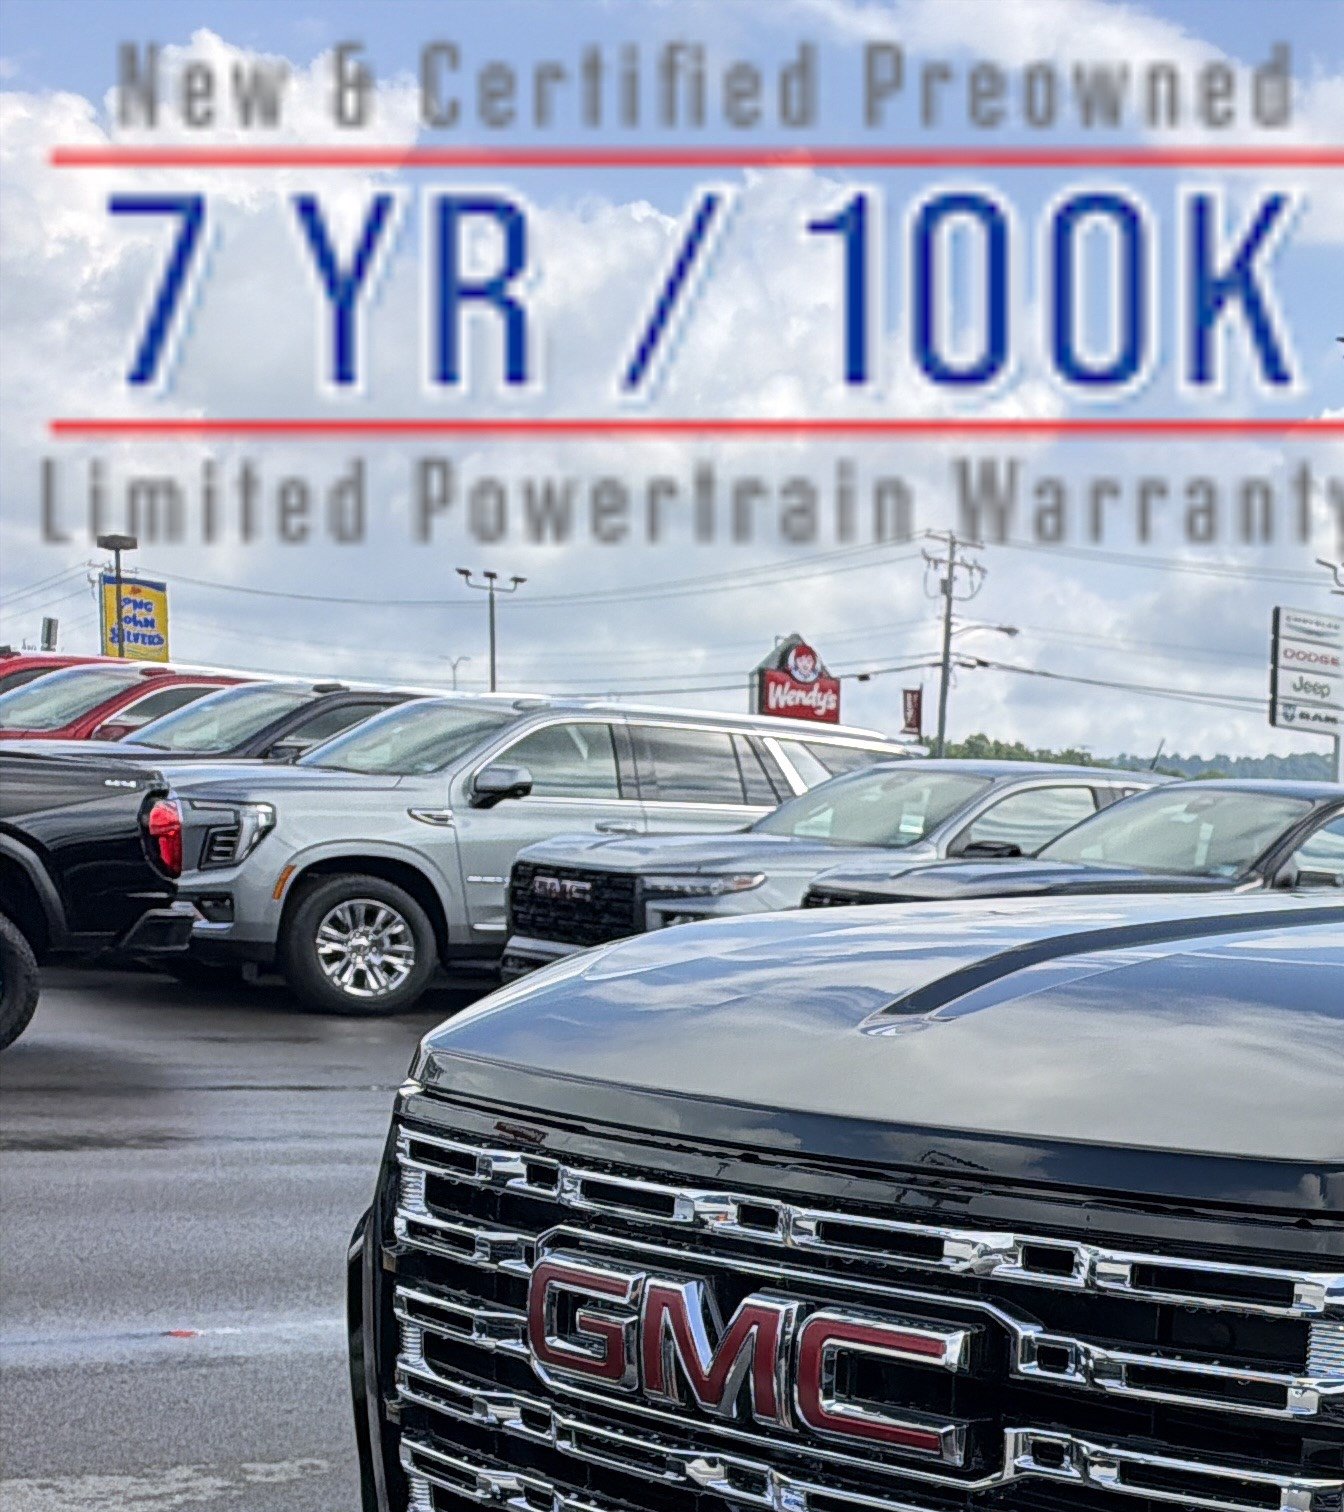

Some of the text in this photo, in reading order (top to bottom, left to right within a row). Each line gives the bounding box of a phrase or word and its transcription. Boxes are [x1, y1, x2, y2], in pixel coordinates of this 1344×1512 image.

[1283, 647, 1340, 667] DODGE
[769, 681, 838, 716] Wendy's
[1292, 675, 1331, 699] Jeep
[527, 1250, 972, 1468] GMC
